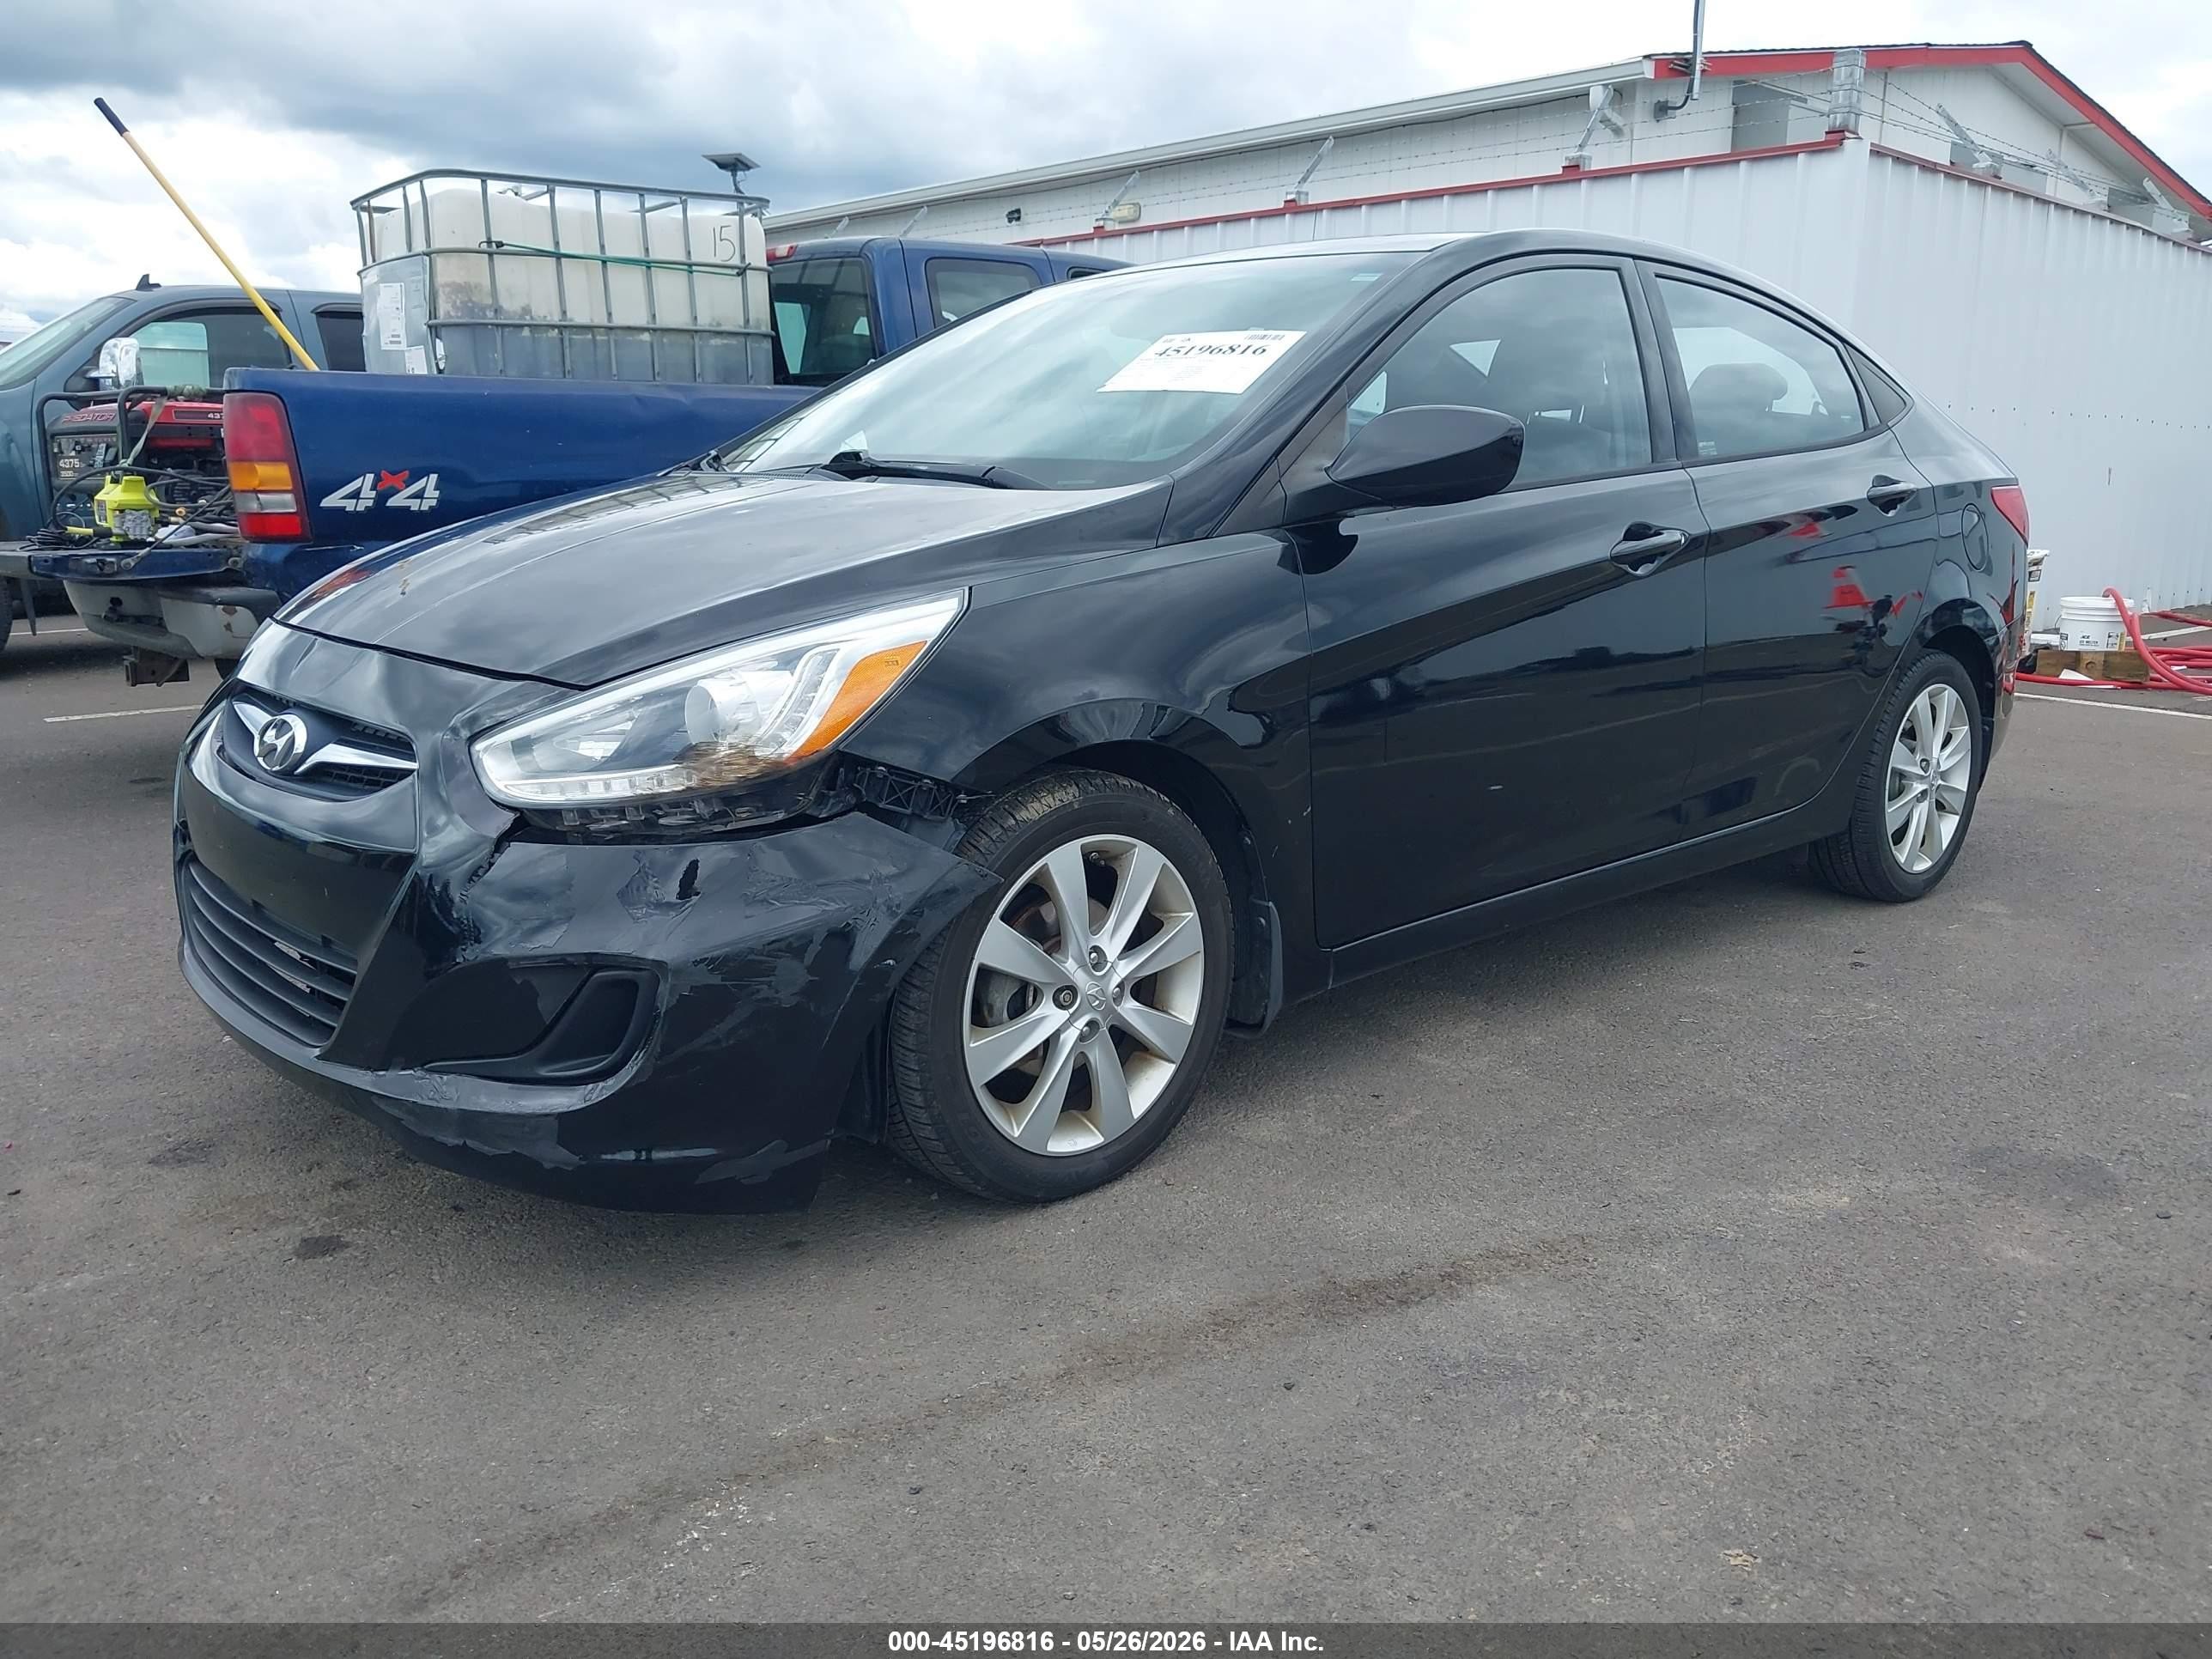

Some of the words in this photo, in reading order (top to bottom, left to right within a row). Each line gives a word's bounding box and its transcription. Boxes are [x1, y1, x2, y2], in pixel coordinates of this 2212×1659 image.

[713, 225, 736, 262] 15
[1154, 343, 1271, 357] 45196816
[59, 459, 80, 468] 4375
